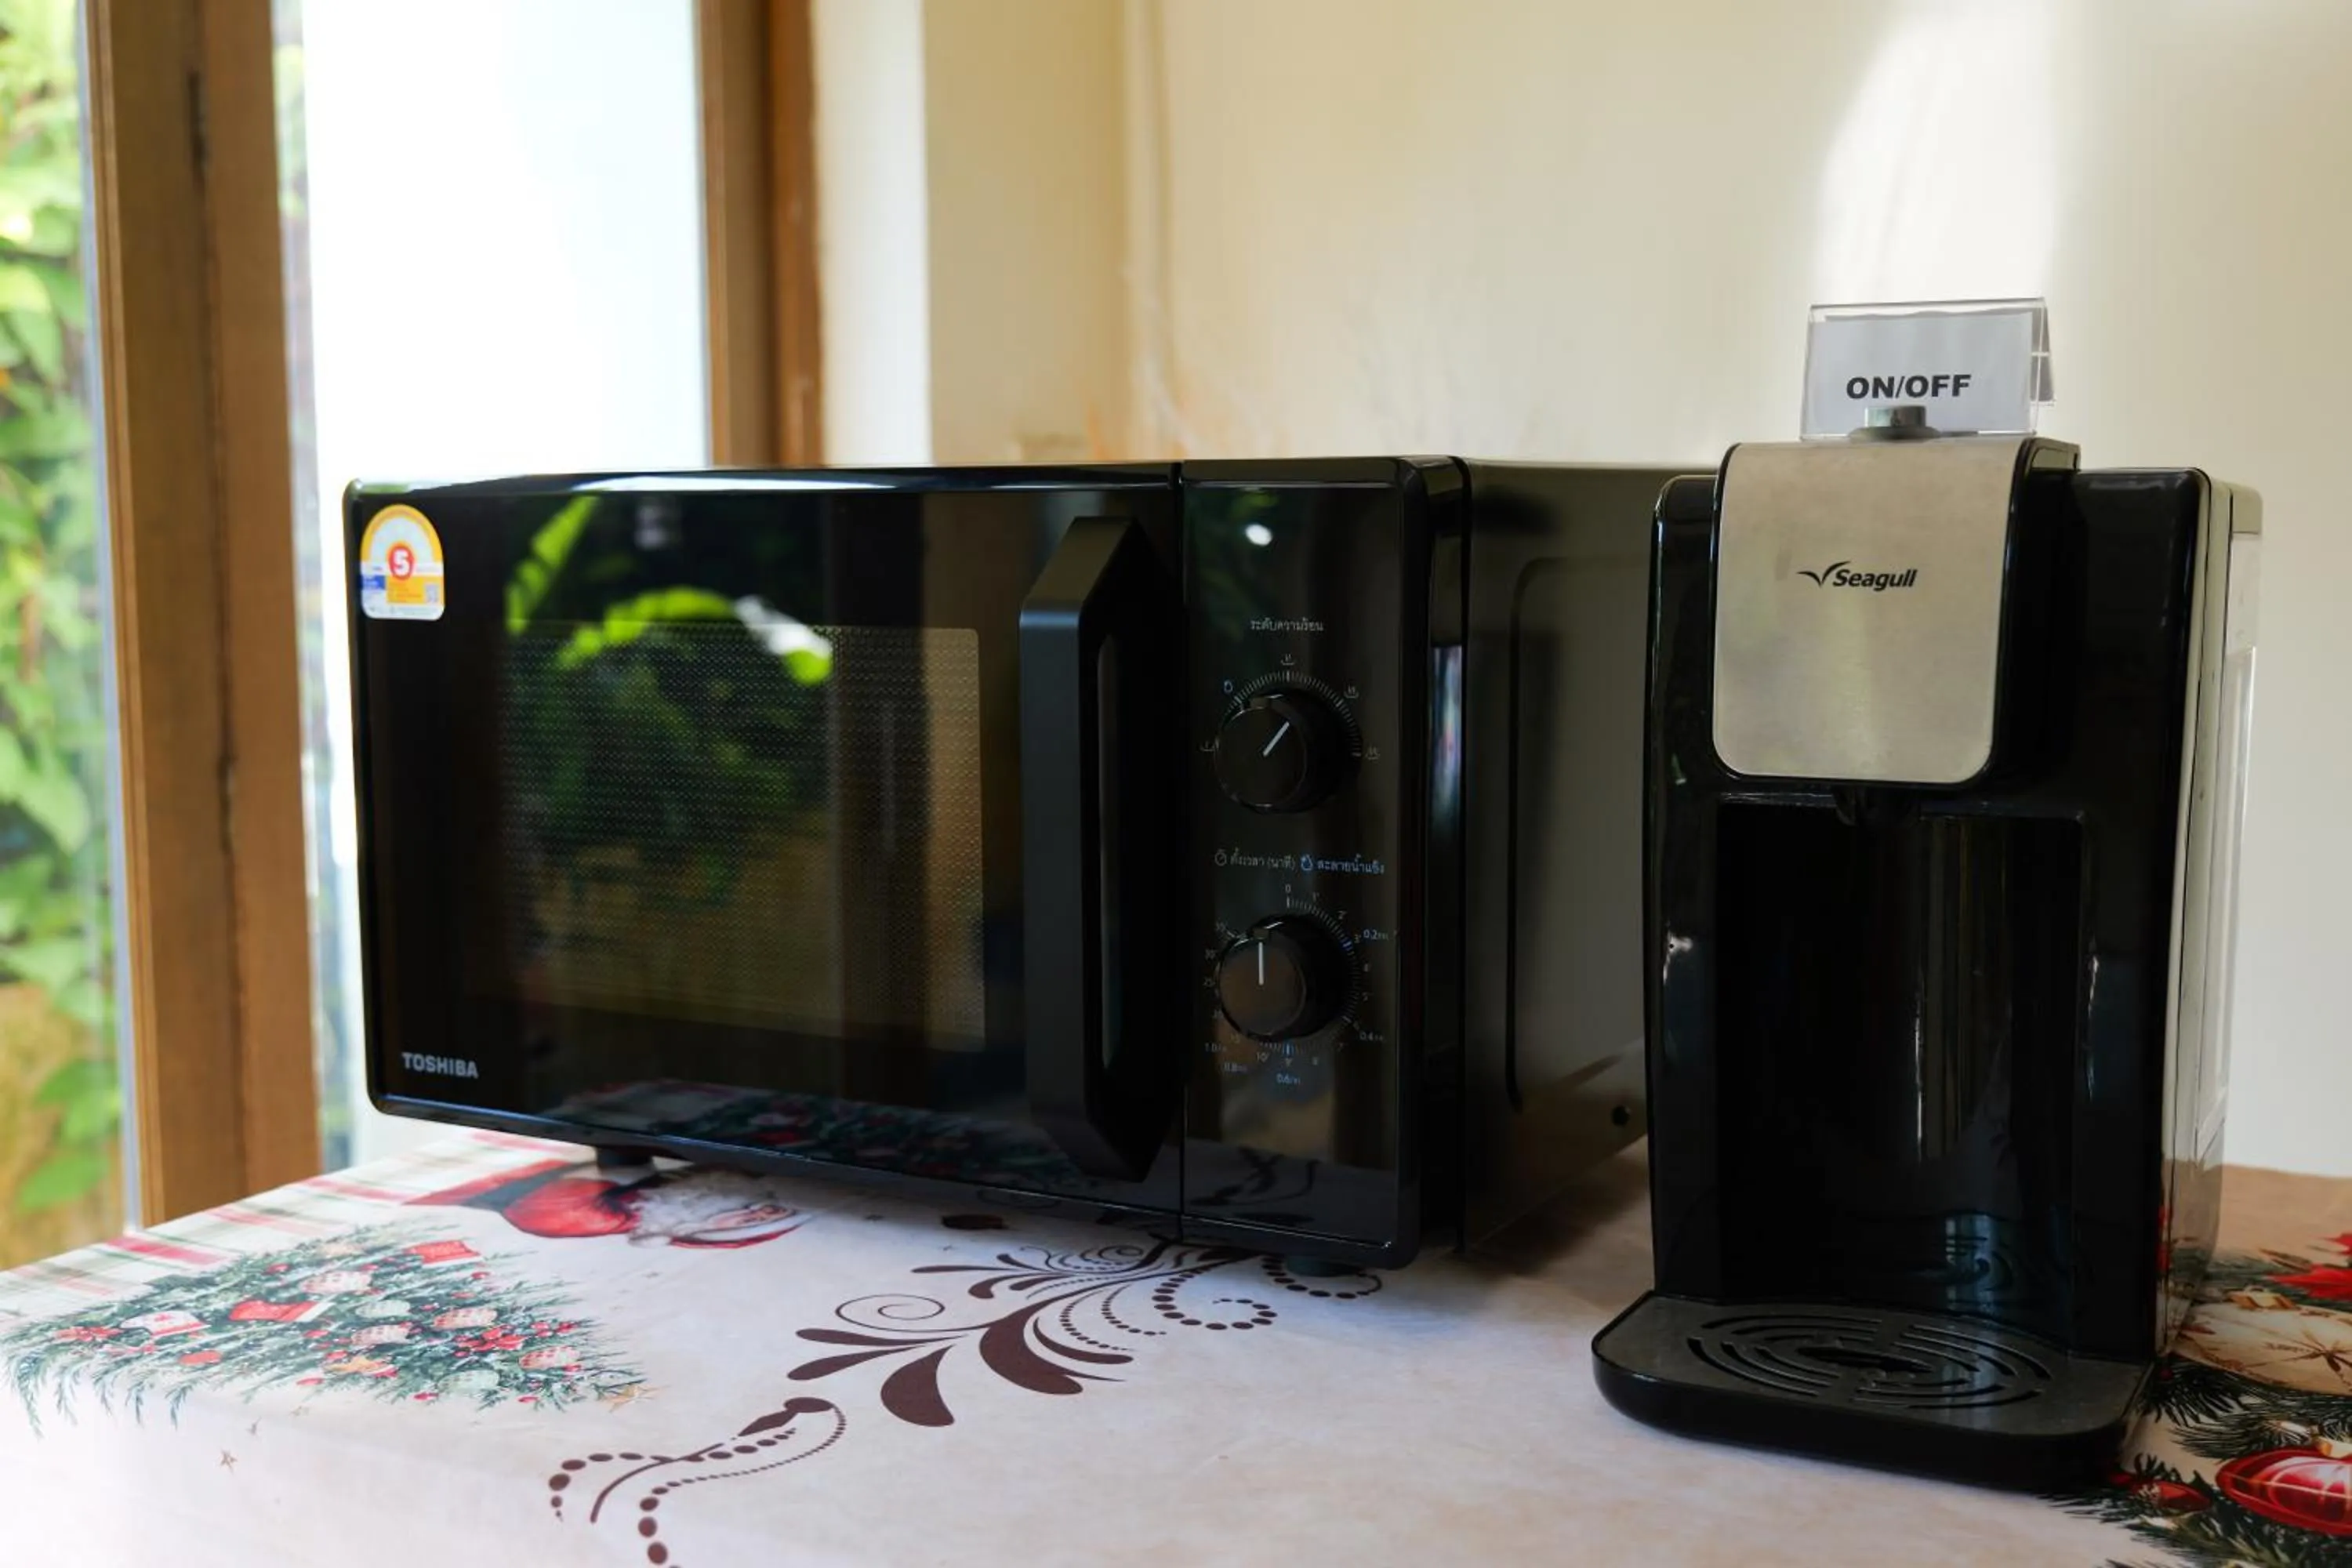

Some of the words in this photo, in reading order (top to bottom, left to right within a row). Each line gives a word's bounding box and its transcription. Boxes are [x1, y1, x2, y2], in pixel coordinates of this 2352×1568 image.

[1846, 375, 1972, 400] ON/OFF
[393, 549, 411, 577] 5
[1833, 568, 1918, 591] Seagull
[401, 1052, 480, 1079] TOSHIBA
